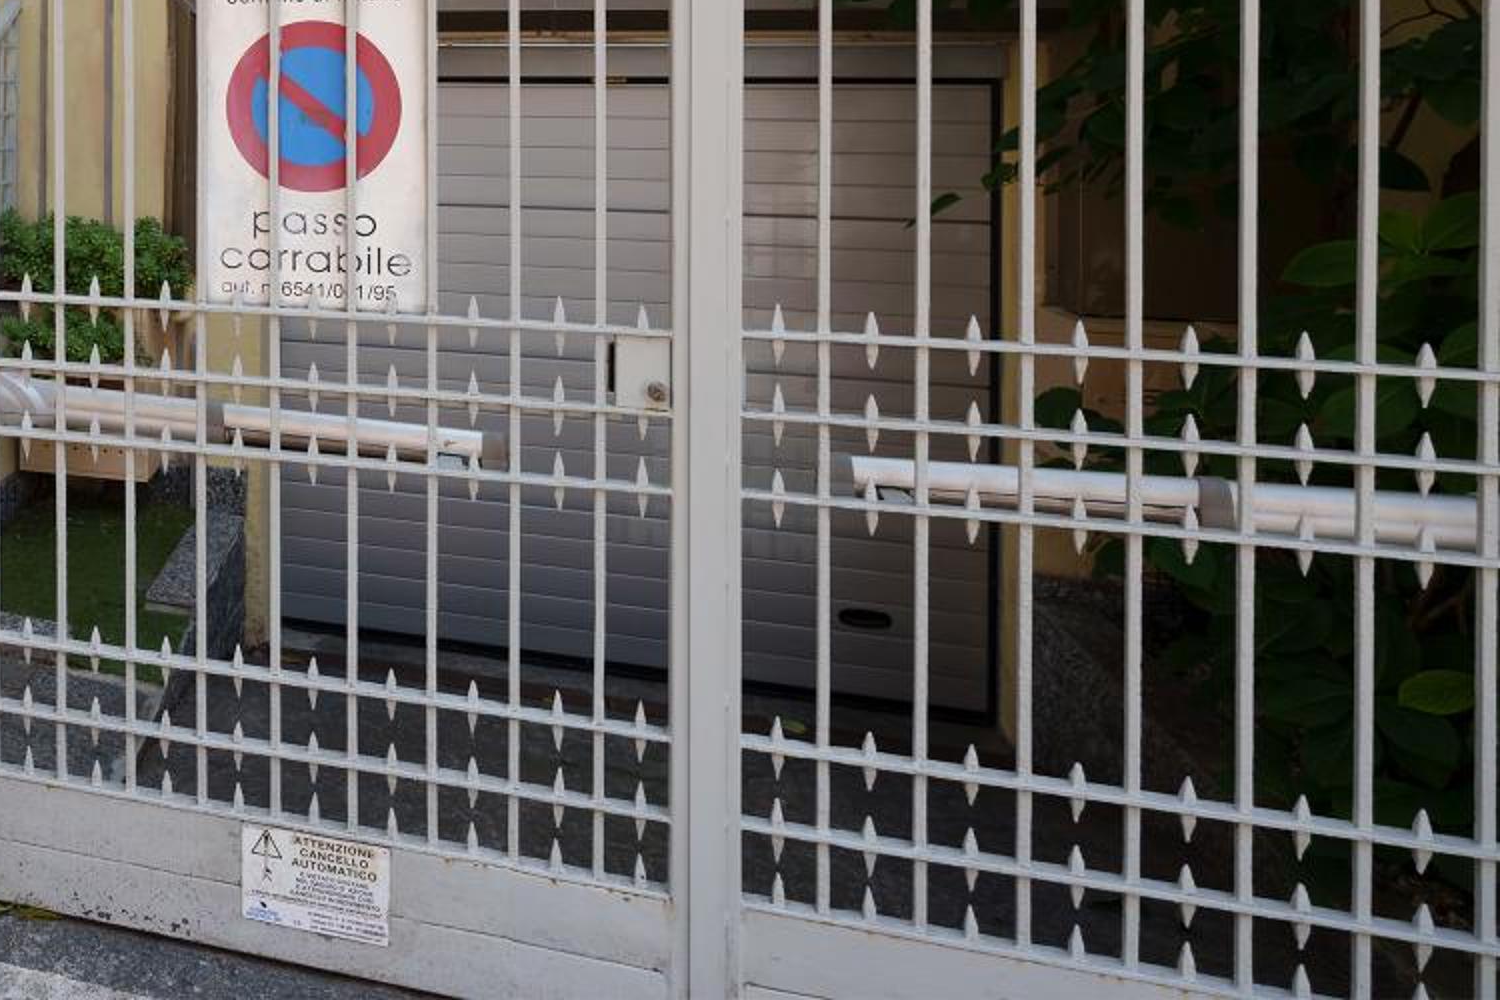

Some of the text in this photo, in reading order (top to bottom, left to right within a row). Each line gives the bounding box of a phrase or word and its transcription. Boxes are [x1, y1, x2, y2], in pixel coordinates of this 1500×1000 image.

[253, 211, 377, 239] passo
[219, 246, 412, 277] carrabile
[281, 281, 397, 301] 6541/01/95
[293, 836, 375, 859] ATTENZIONE
[299, 847, 369, 869] CANCELLO
[291, 857, 377, 882] AUTOMATICO
